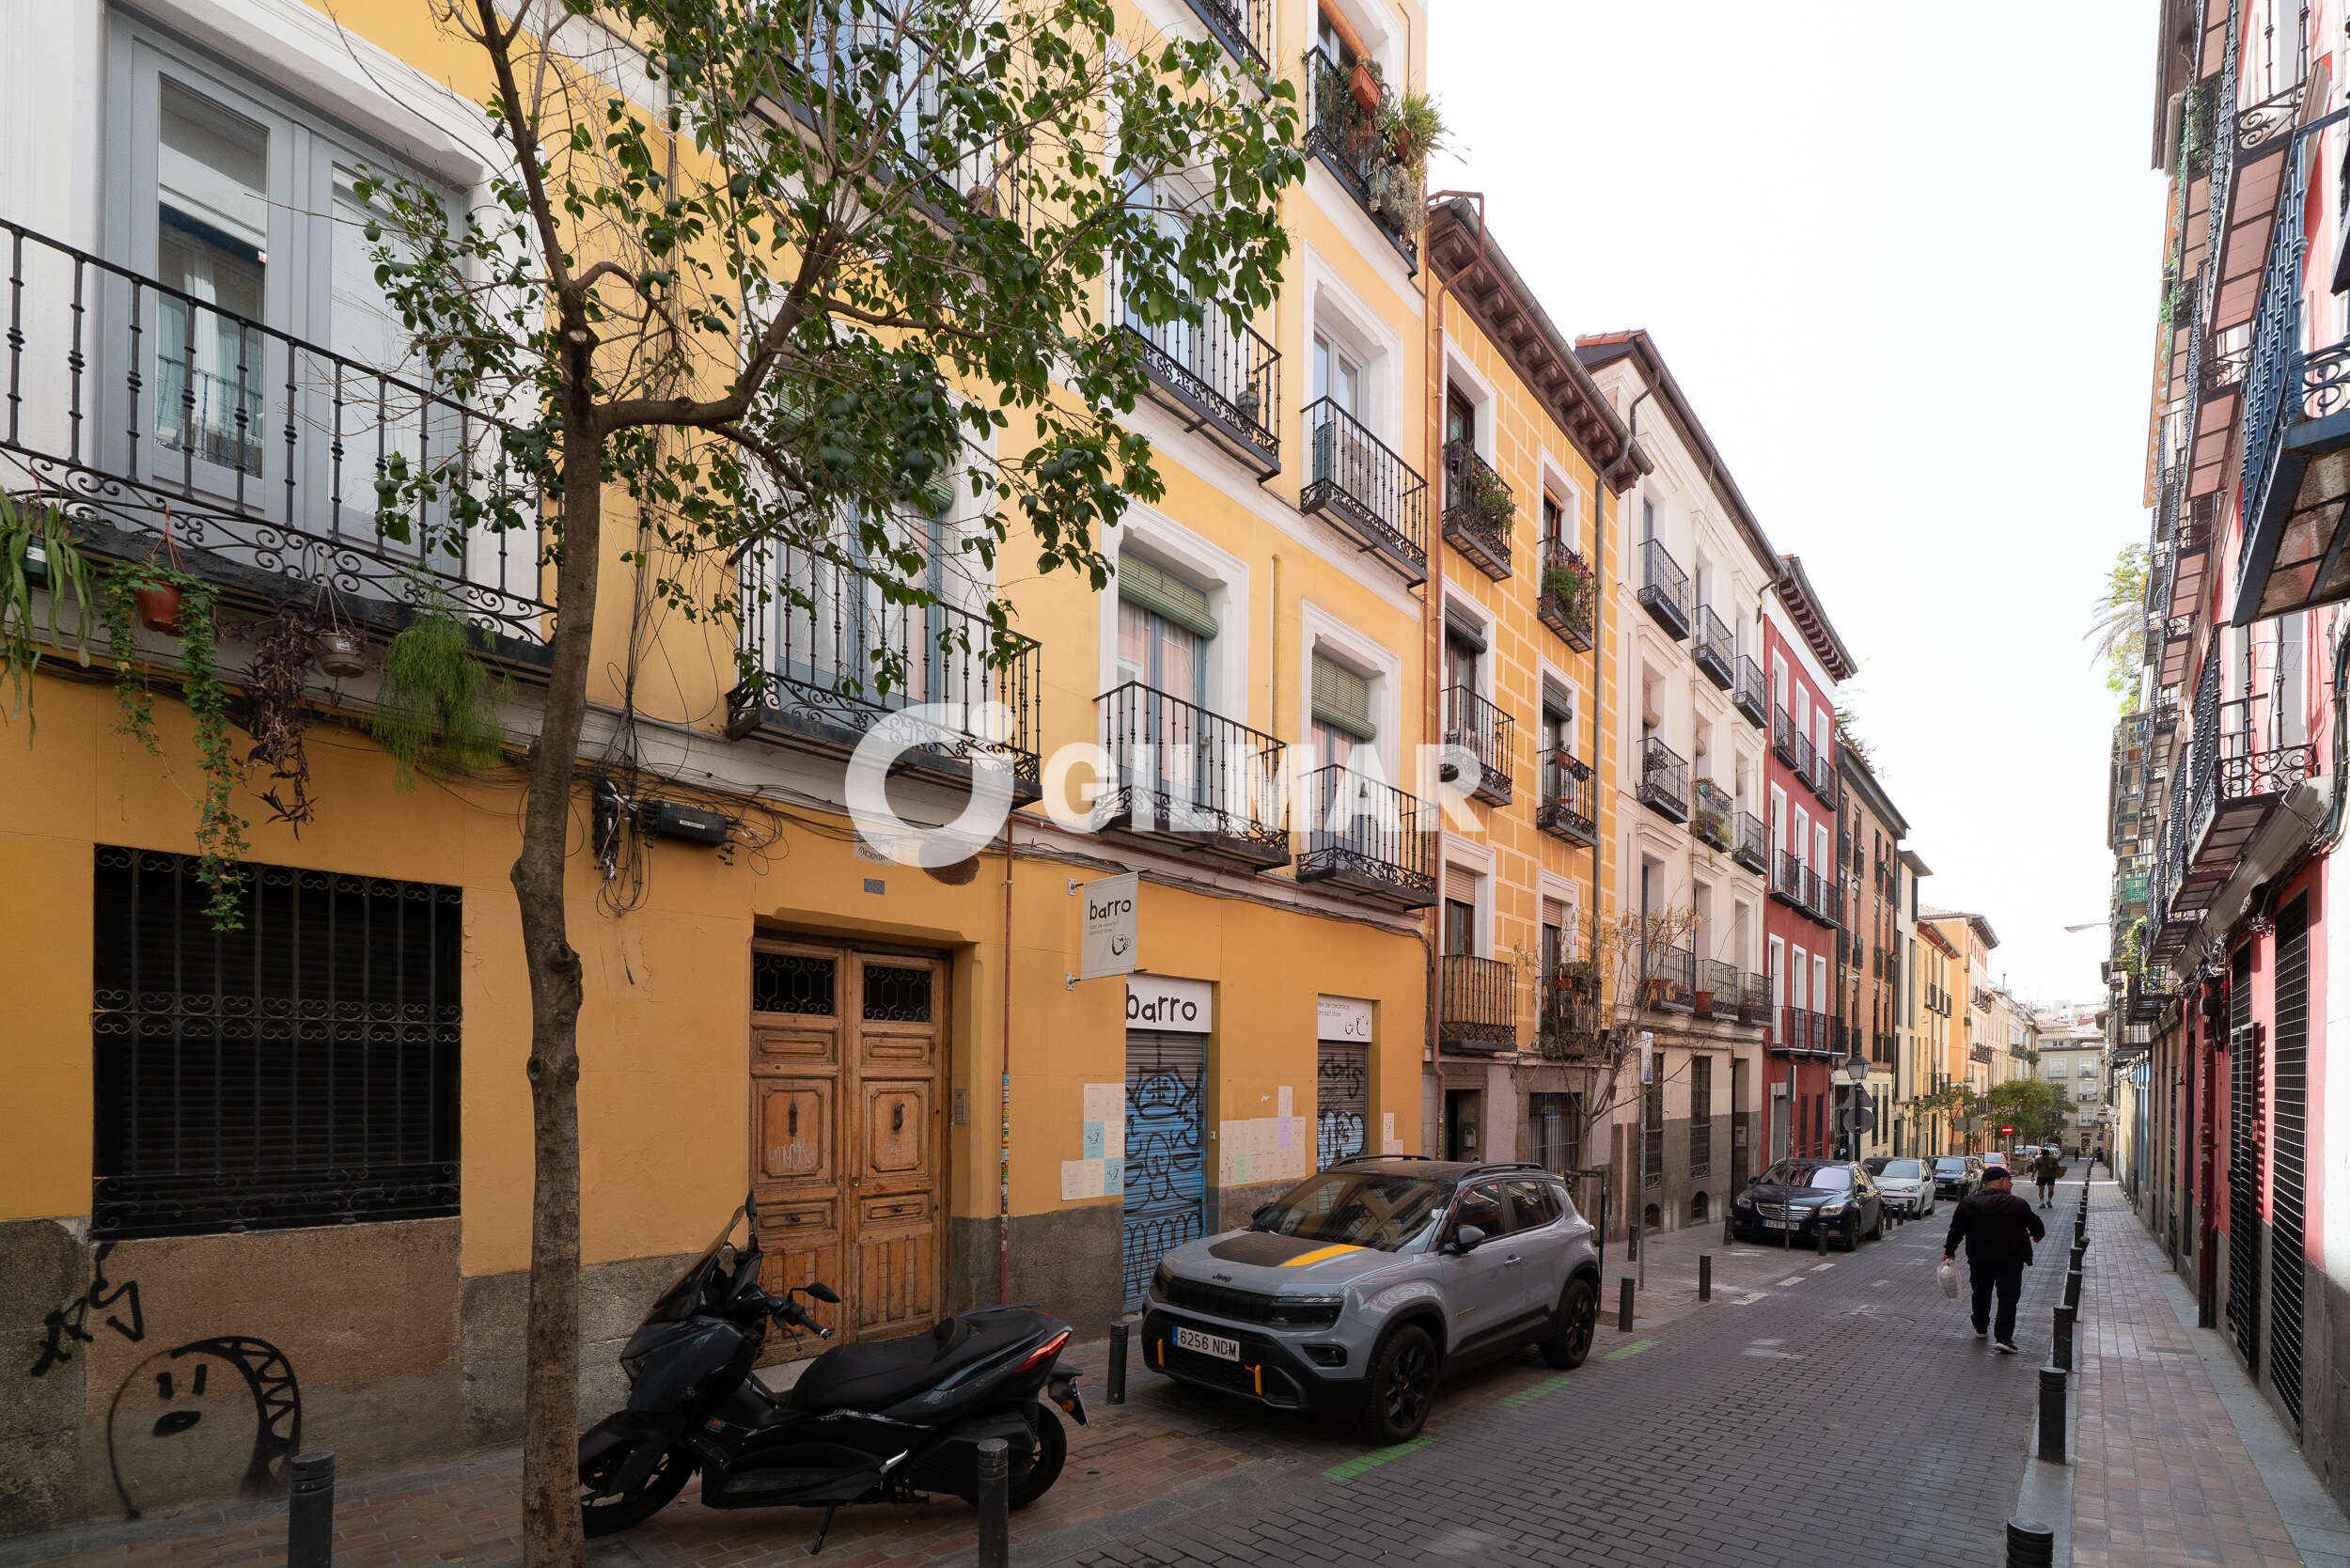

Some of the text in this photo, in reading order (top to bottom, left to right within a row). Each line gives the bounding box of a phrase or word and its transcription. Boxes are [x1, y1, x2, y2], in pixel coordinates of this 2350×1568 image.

[1089, 899, 1132, 921] barro
[1126, 982, 1198, 1023] barro
[1212, 1272, 1232, 1282] Jeep
[1180, 1330, 1237, 1357] 6256 NDM
